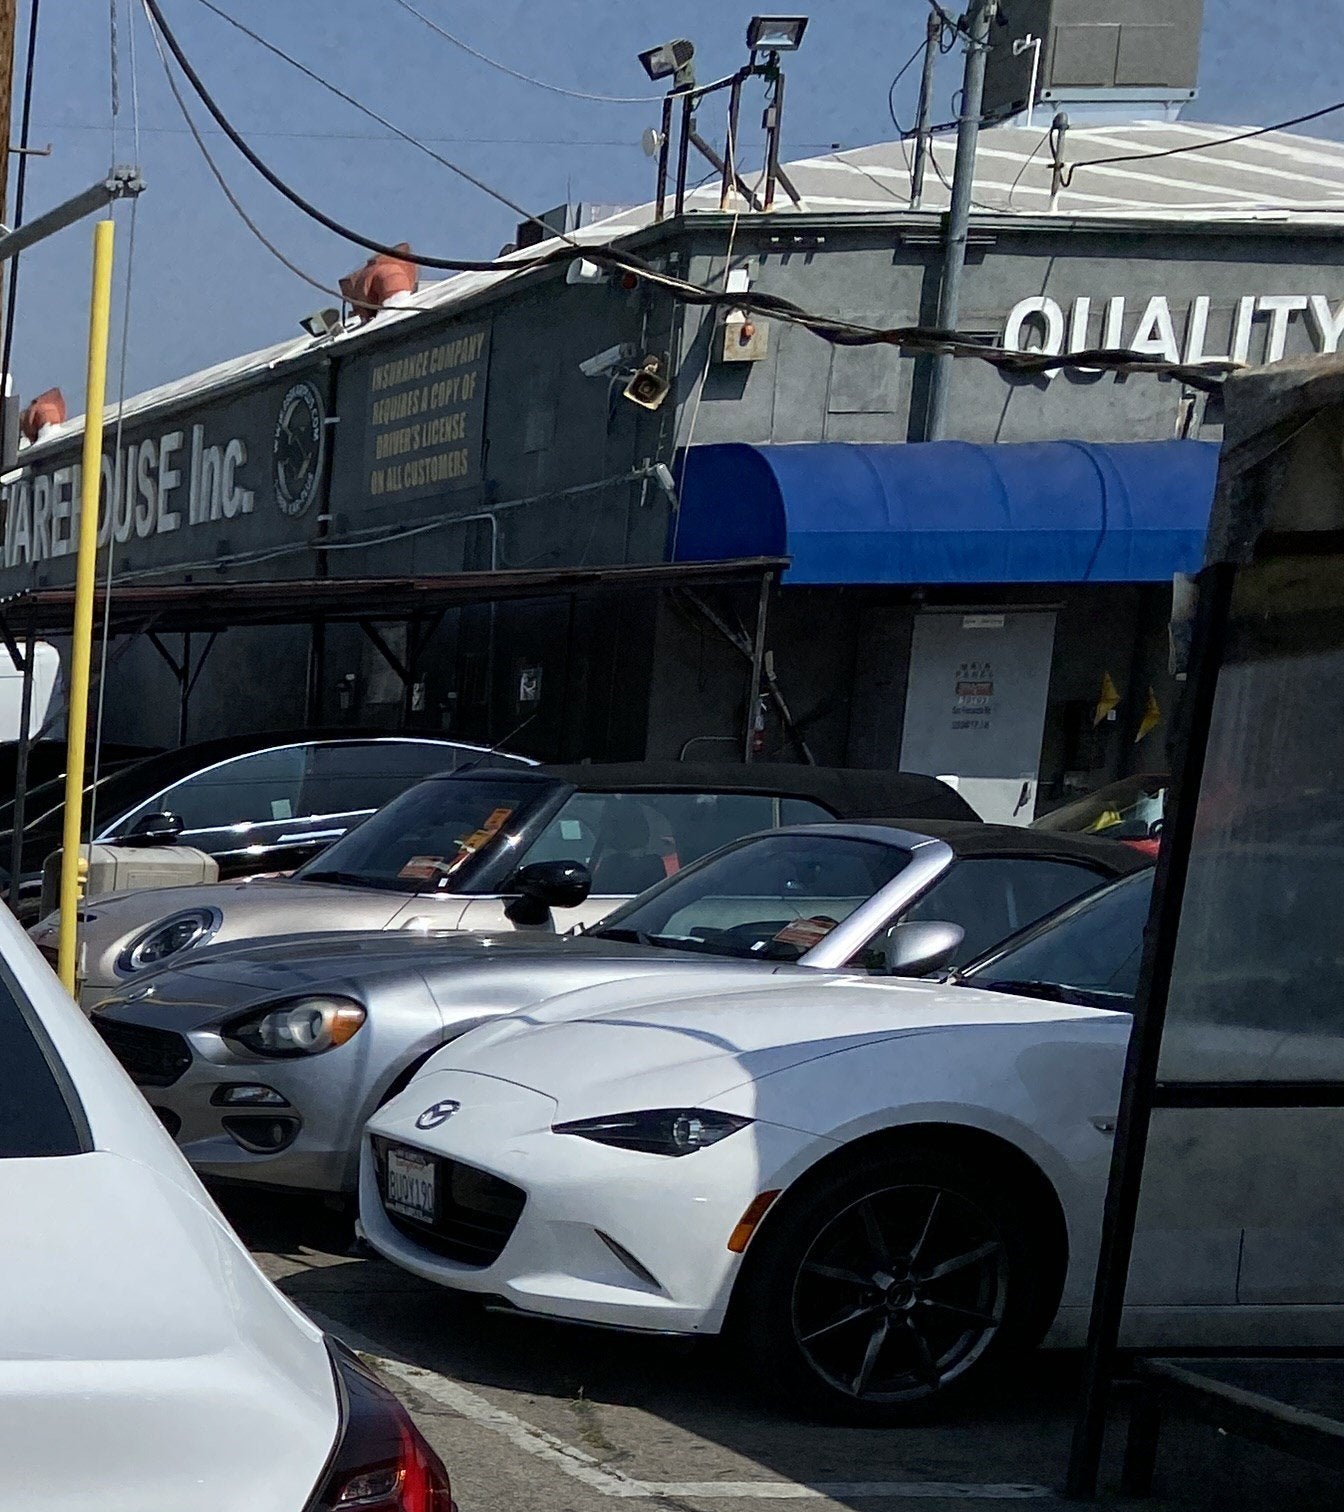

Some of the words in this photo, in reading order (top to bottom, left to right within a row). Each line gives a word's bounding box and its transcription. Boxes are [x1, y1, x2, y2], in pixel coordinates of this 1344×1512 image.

[373, 349, 429, 392] INSURANCE
[430, 332, 484, 374] COMPANY
[1004, 296, 1344, 379] QUALITY
[373, 388, 419, 426] REQUIRES
[421, 386, 428, 412] A
[430, 376, 460, 410] COPY
[462, 371, 477, 400] OF
[376, 425, 421, 460] DRIVER'S
[422, 411, 466, 448] LICENSE
[189, 424, 255, 526] Inc.
[371, 470, 384, 495] ON
[386, 465, 401, 492] ALL
[404, 448, 468, 488] CUSTOMERS
